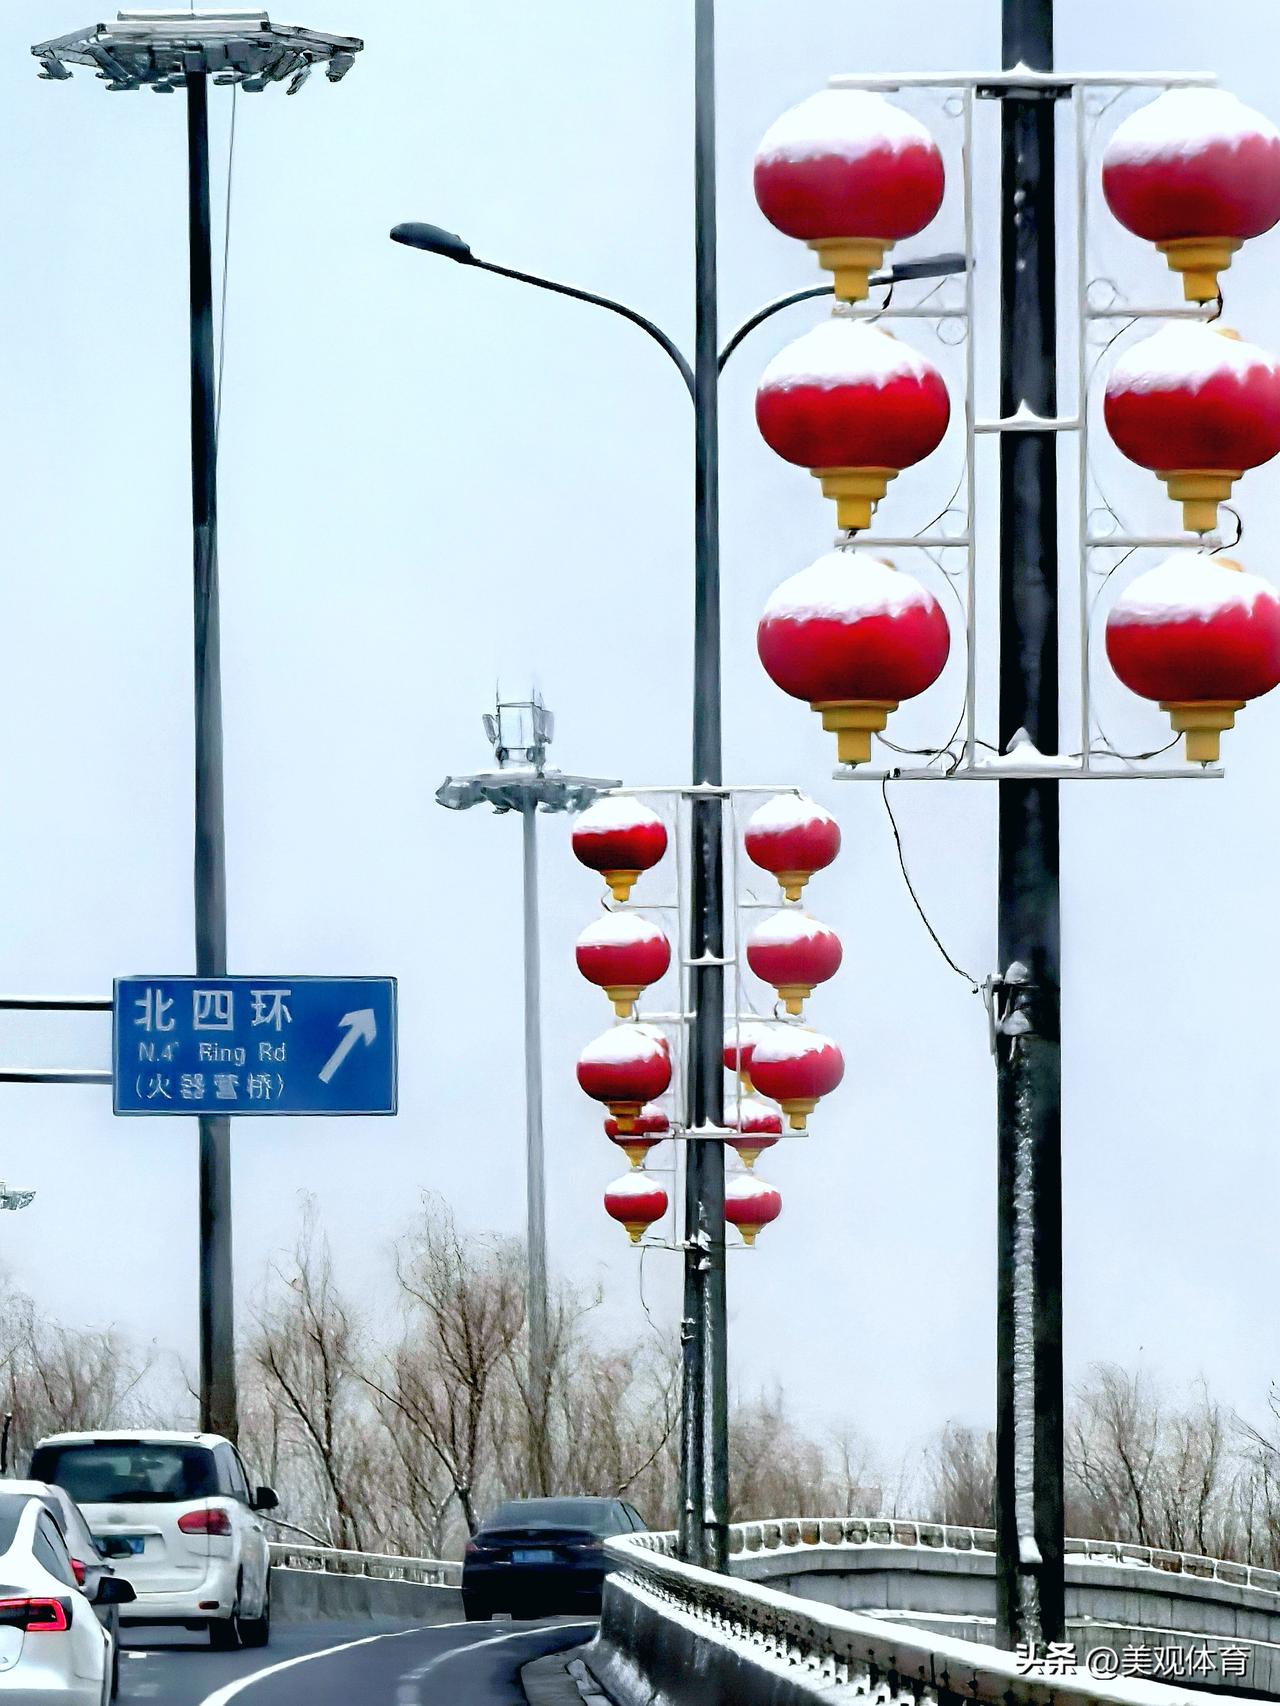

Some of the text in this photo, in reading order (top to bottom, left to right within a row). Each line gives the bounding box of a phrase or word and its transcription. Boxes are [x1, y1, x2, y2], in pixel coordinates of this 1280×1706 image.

[134, 988, 293, 1032] 北四环
[199, 1042, 246, 1066] Ring
[258, 1042, 287, 1062] Rd
